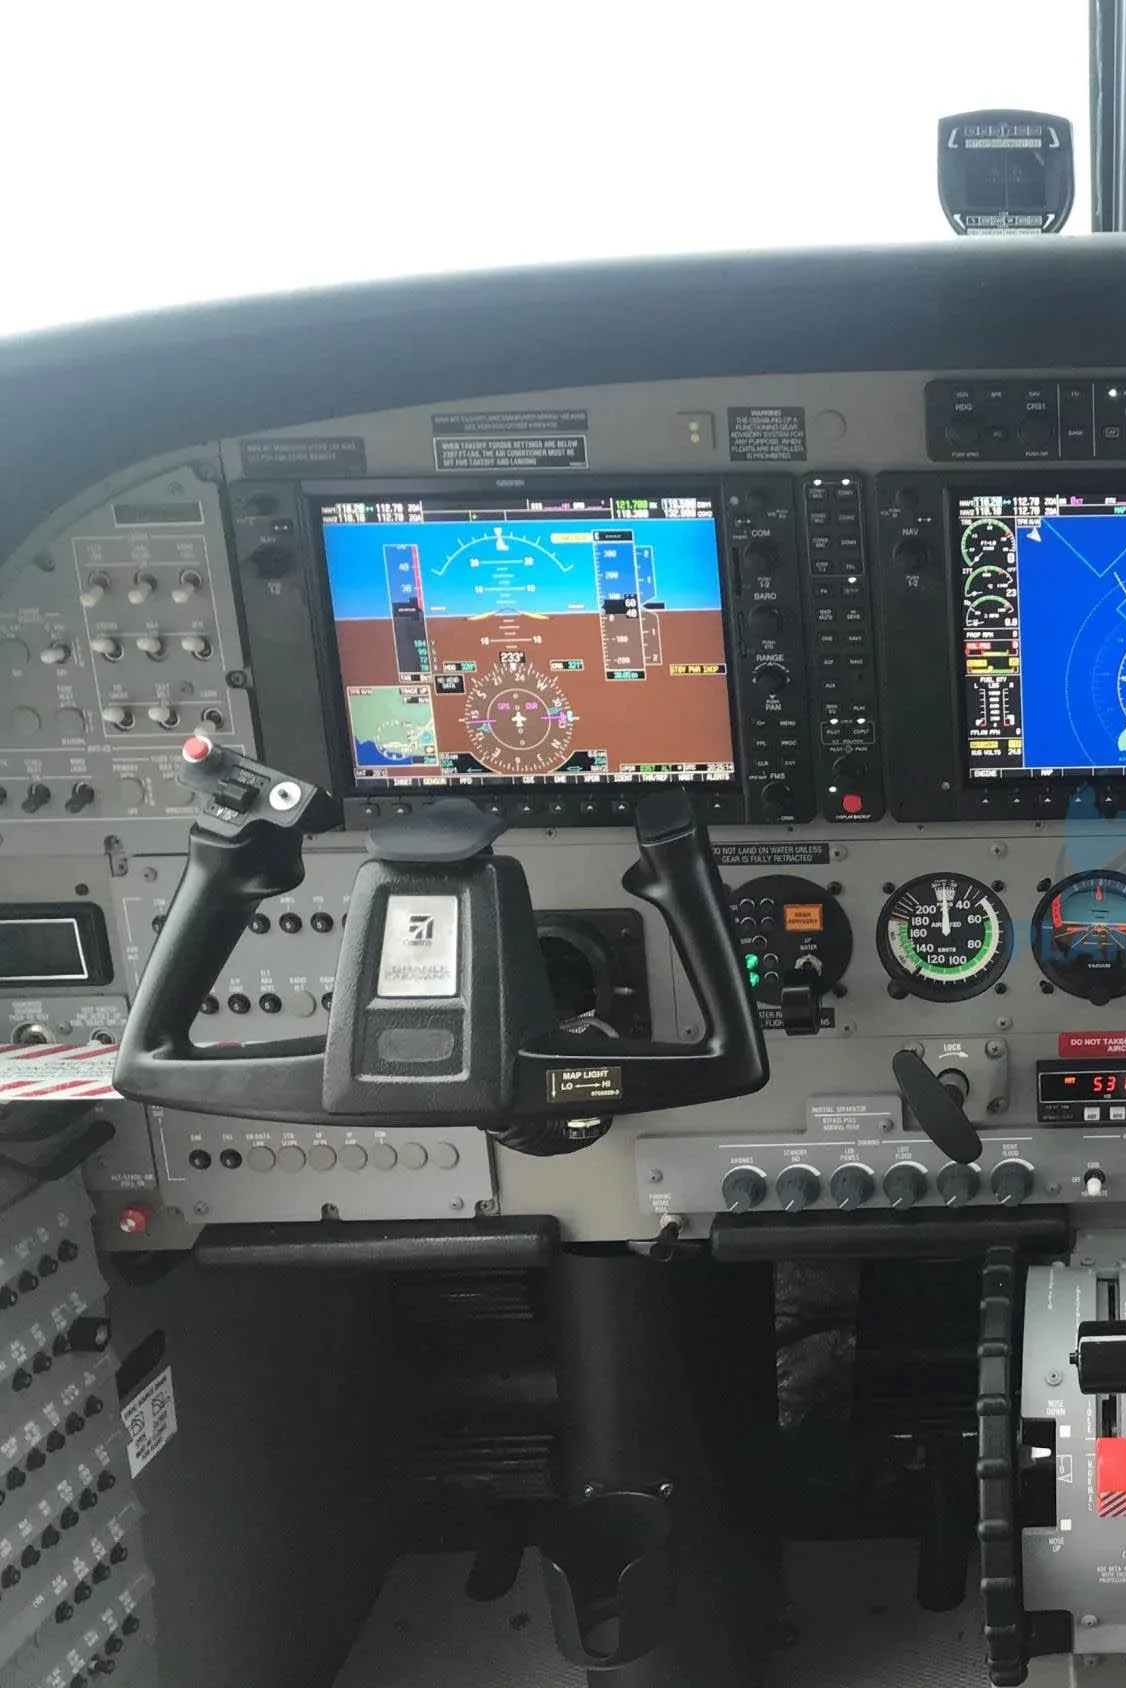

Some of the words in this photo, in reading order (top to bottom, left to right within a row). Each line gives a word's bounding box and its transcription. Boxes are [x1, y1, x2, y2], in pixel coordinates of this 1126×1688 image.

[902, 528, 918, 536] NAV
[500, 652, 524, 662] 233°
[756, 654, 784, 662] RANGE
[770, 772, 786, 780] FMS
[738, 846, 756, 854] LAND
[758, 846, 769, 854] ON
[770, 846, 794, 854] WATER
[794, 846, 822, 854] UNLESS
[722, 856, 740, 864] GEAR
[750, 855, 772, 863] FULLY
[774, 854, 812, 862] RETRACTED
[916, 905, 936, 914] 200
[956, 900, 970, 910] 40
[912, 916, 930, 926] 180
[967, 914, 982, 924] 60
[910, 928, 928, 938] 160
[916, 944, 934, 953] 140
[967, 940, 982, 949] 80
[928, 954, 946, 964] 120
[950, 956, 967, 965] 100
[1085, 1038, 1100, 1046] NOT
[942, 1042, 963, 1052] LOCK
[562, 1072, 582, 1080] MAP
[584, 1070, 608, 1078] LIGHT
[561, 1082, 574, 1090] LO
[602, 1080, 611, 1088] HI
[1048, 1400, 1064, 1408] NOSE
[1046, 1408, 1066, 1416] DOWN
